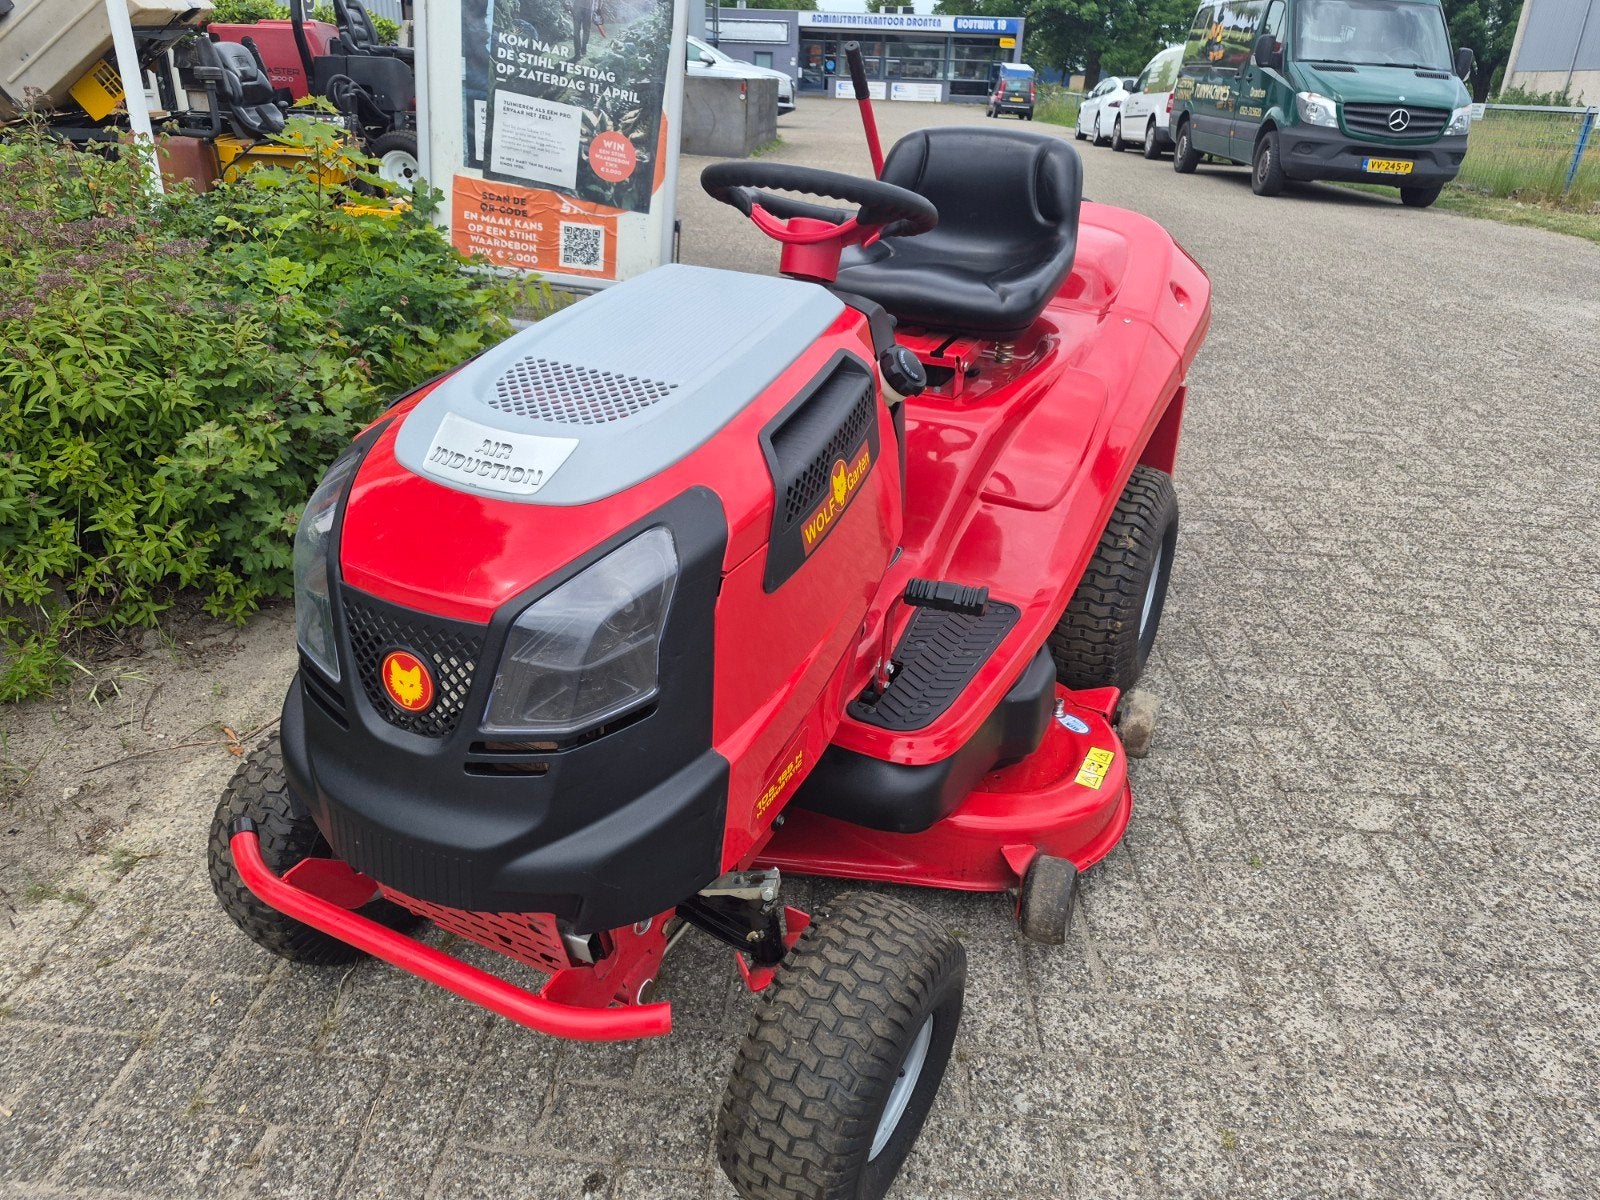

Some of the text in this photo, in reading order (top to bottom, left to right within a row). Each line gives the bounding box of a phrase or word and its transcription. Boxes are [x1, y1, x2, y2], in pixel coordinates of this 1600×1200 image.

[811, 14, 942, 28] ADMINISTRATIEKANTOOR DRONTEN
[498, 32, 569, 58] KOM NAAR
[268, 67, 300, 75] ASTER
[497, 47, 616, 83] DE STIHL TESTDAG
[496, 62, 641, 104] OP ZATERDAG 11 APRIL
[502, 106, 525, 115] ERVAAR
[503, 100, 534, 111] TUINIEREN
[603, 139, 625, 152] WIN
[1371, 160, 1410, 172] VV-245-P
[482, 191, 526, 206] SCAN DE
[480, 202, 528, 217] QR-CODE
[463, 210, 544, 231] EN MAAK KANS
[467, 223, 538, 242] OP EEN STIHL
[469, 234, 537, 253] WAARDEBON
[474, 438, 513, 460] AIR
[429, 446, 544, 486] INDUCTION
[804, 451, 870, 544] WOLF Garten
